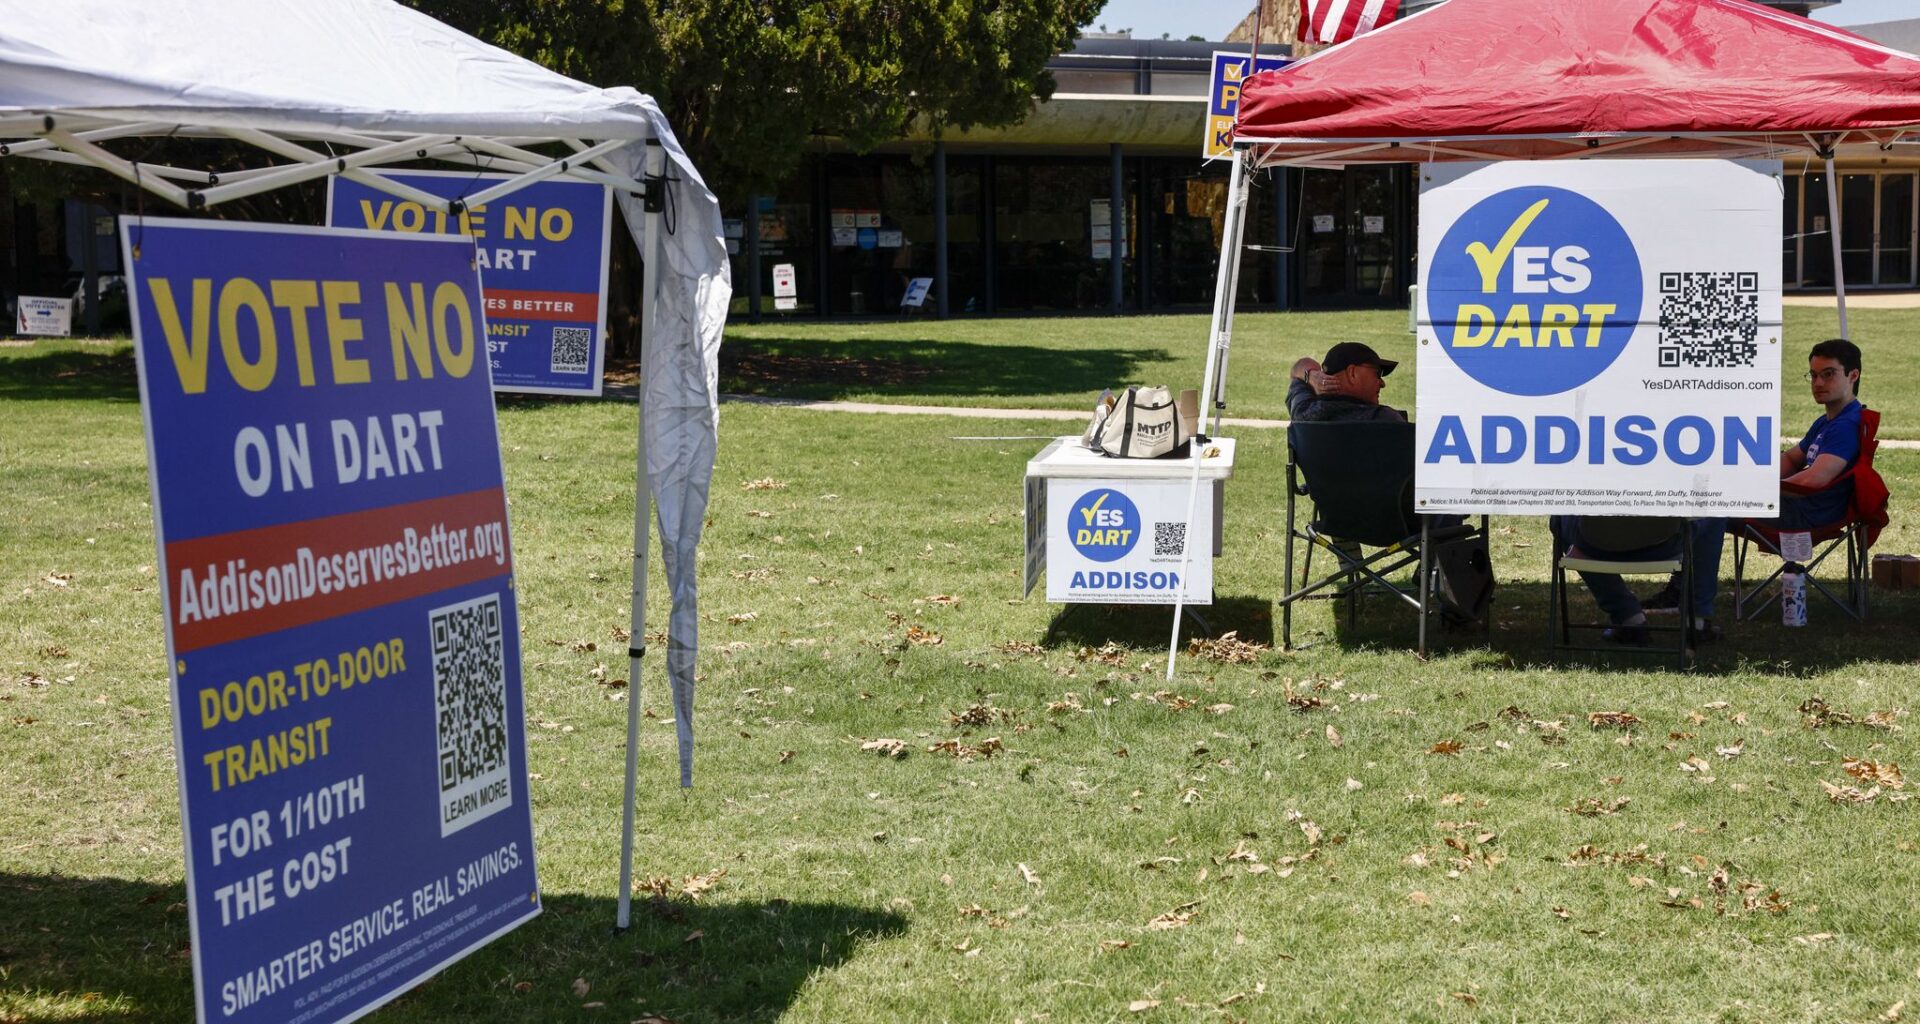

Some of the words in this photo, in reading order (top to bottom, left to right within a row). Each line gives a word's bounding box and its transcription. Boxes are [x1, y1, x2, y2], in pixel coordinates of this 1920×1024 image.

[360, 200, 487, 238] VOTE
[504, 206, 573, 242] NO
[476, 248, 536, 271] ART
[1465, 199, 1591, 294] YES
[513, 300, 574, 312] BETTER
[1452, 304, 1616, 348] DART
[147, 277, 371, 395] VOTE
[384, 281, 474, 381] NO
[486, 324, 530, 336] ANSIT
[488, 341, 508, 352] ST
[1642, 378, 1773, 392] YesDARTAddison.com
[1137, 421, 1171, 435] MTTP
[1424, 415, 1772, 466] ADDISON
[234, 422, 314, 498] ON
[331, 410, 444, 484] DART
[1081, 492, 1124, 526] YES
[1076, 529, 1132, 546] DART
[179, 521, 505, 625] AddisonDeservesBetter.org
[1070, 571, 1186, 589] ADDISON
[200, 637, 407, 730] DOOR-TO-DOOR
[204, 717, 332, 792] TRANSIT
[210, 809, 272, 867] FOR
[280, 774, 366, 840] 1/10TH
[444, 796, 478, 824] LEARN
[480, 778, 508, 807] MORE
[214, 868, 276, 928] THE
[283, 836, 352, 899] COST
[222, 940, 324, 1016] SMARTER
[328, 898, 408, 964] SERVICE.
[412, 876, 455, 921] REAL
[457, 842, 522, 896] SAVINGS.
